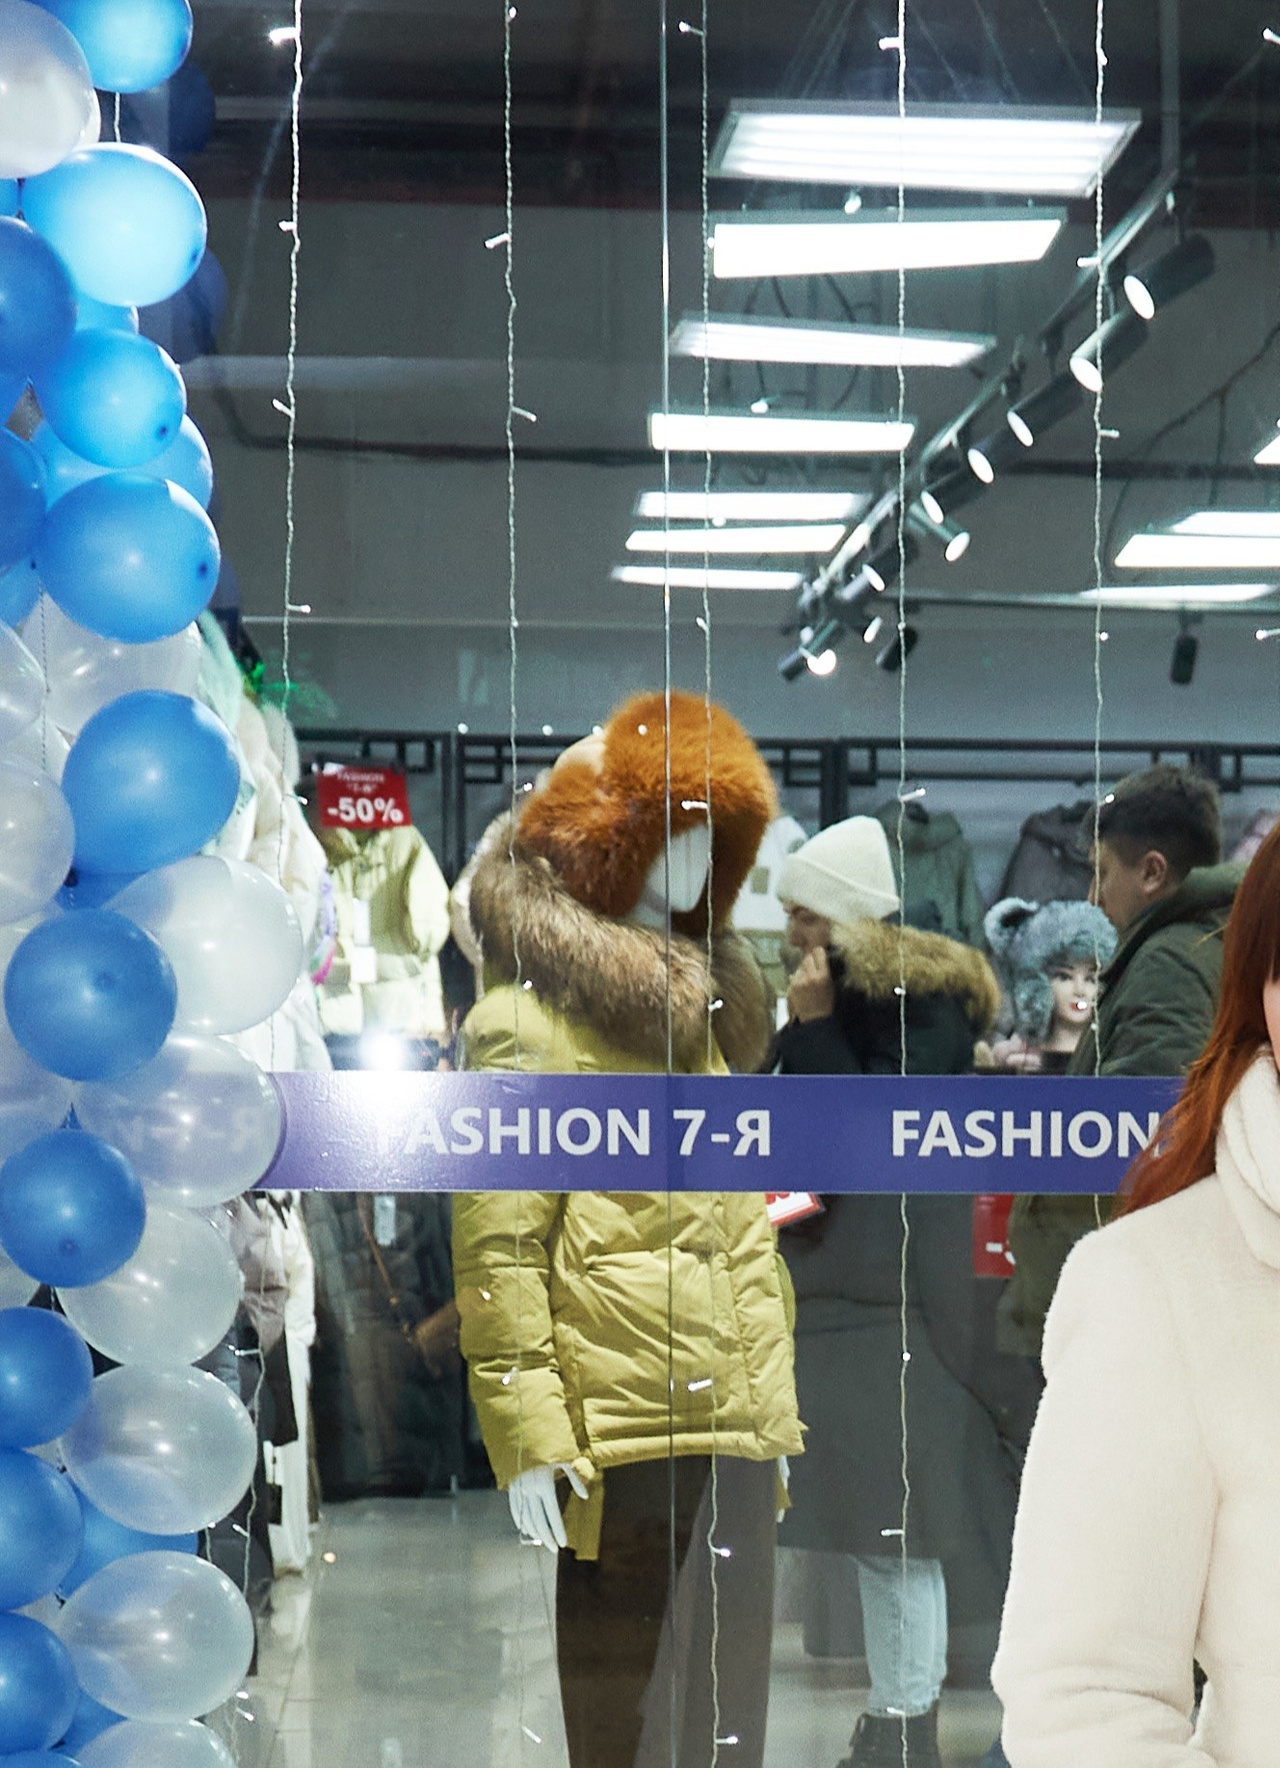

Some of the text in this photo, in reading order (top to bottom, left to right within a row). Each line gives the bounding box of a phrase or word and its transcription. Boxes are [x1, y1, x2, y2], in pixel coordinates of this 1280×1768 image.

[327, 797, 404, 823] -50%
[672, 1108, 771, 1157] 7-Я
[891, 1109, 1161, 1159] FASHION
